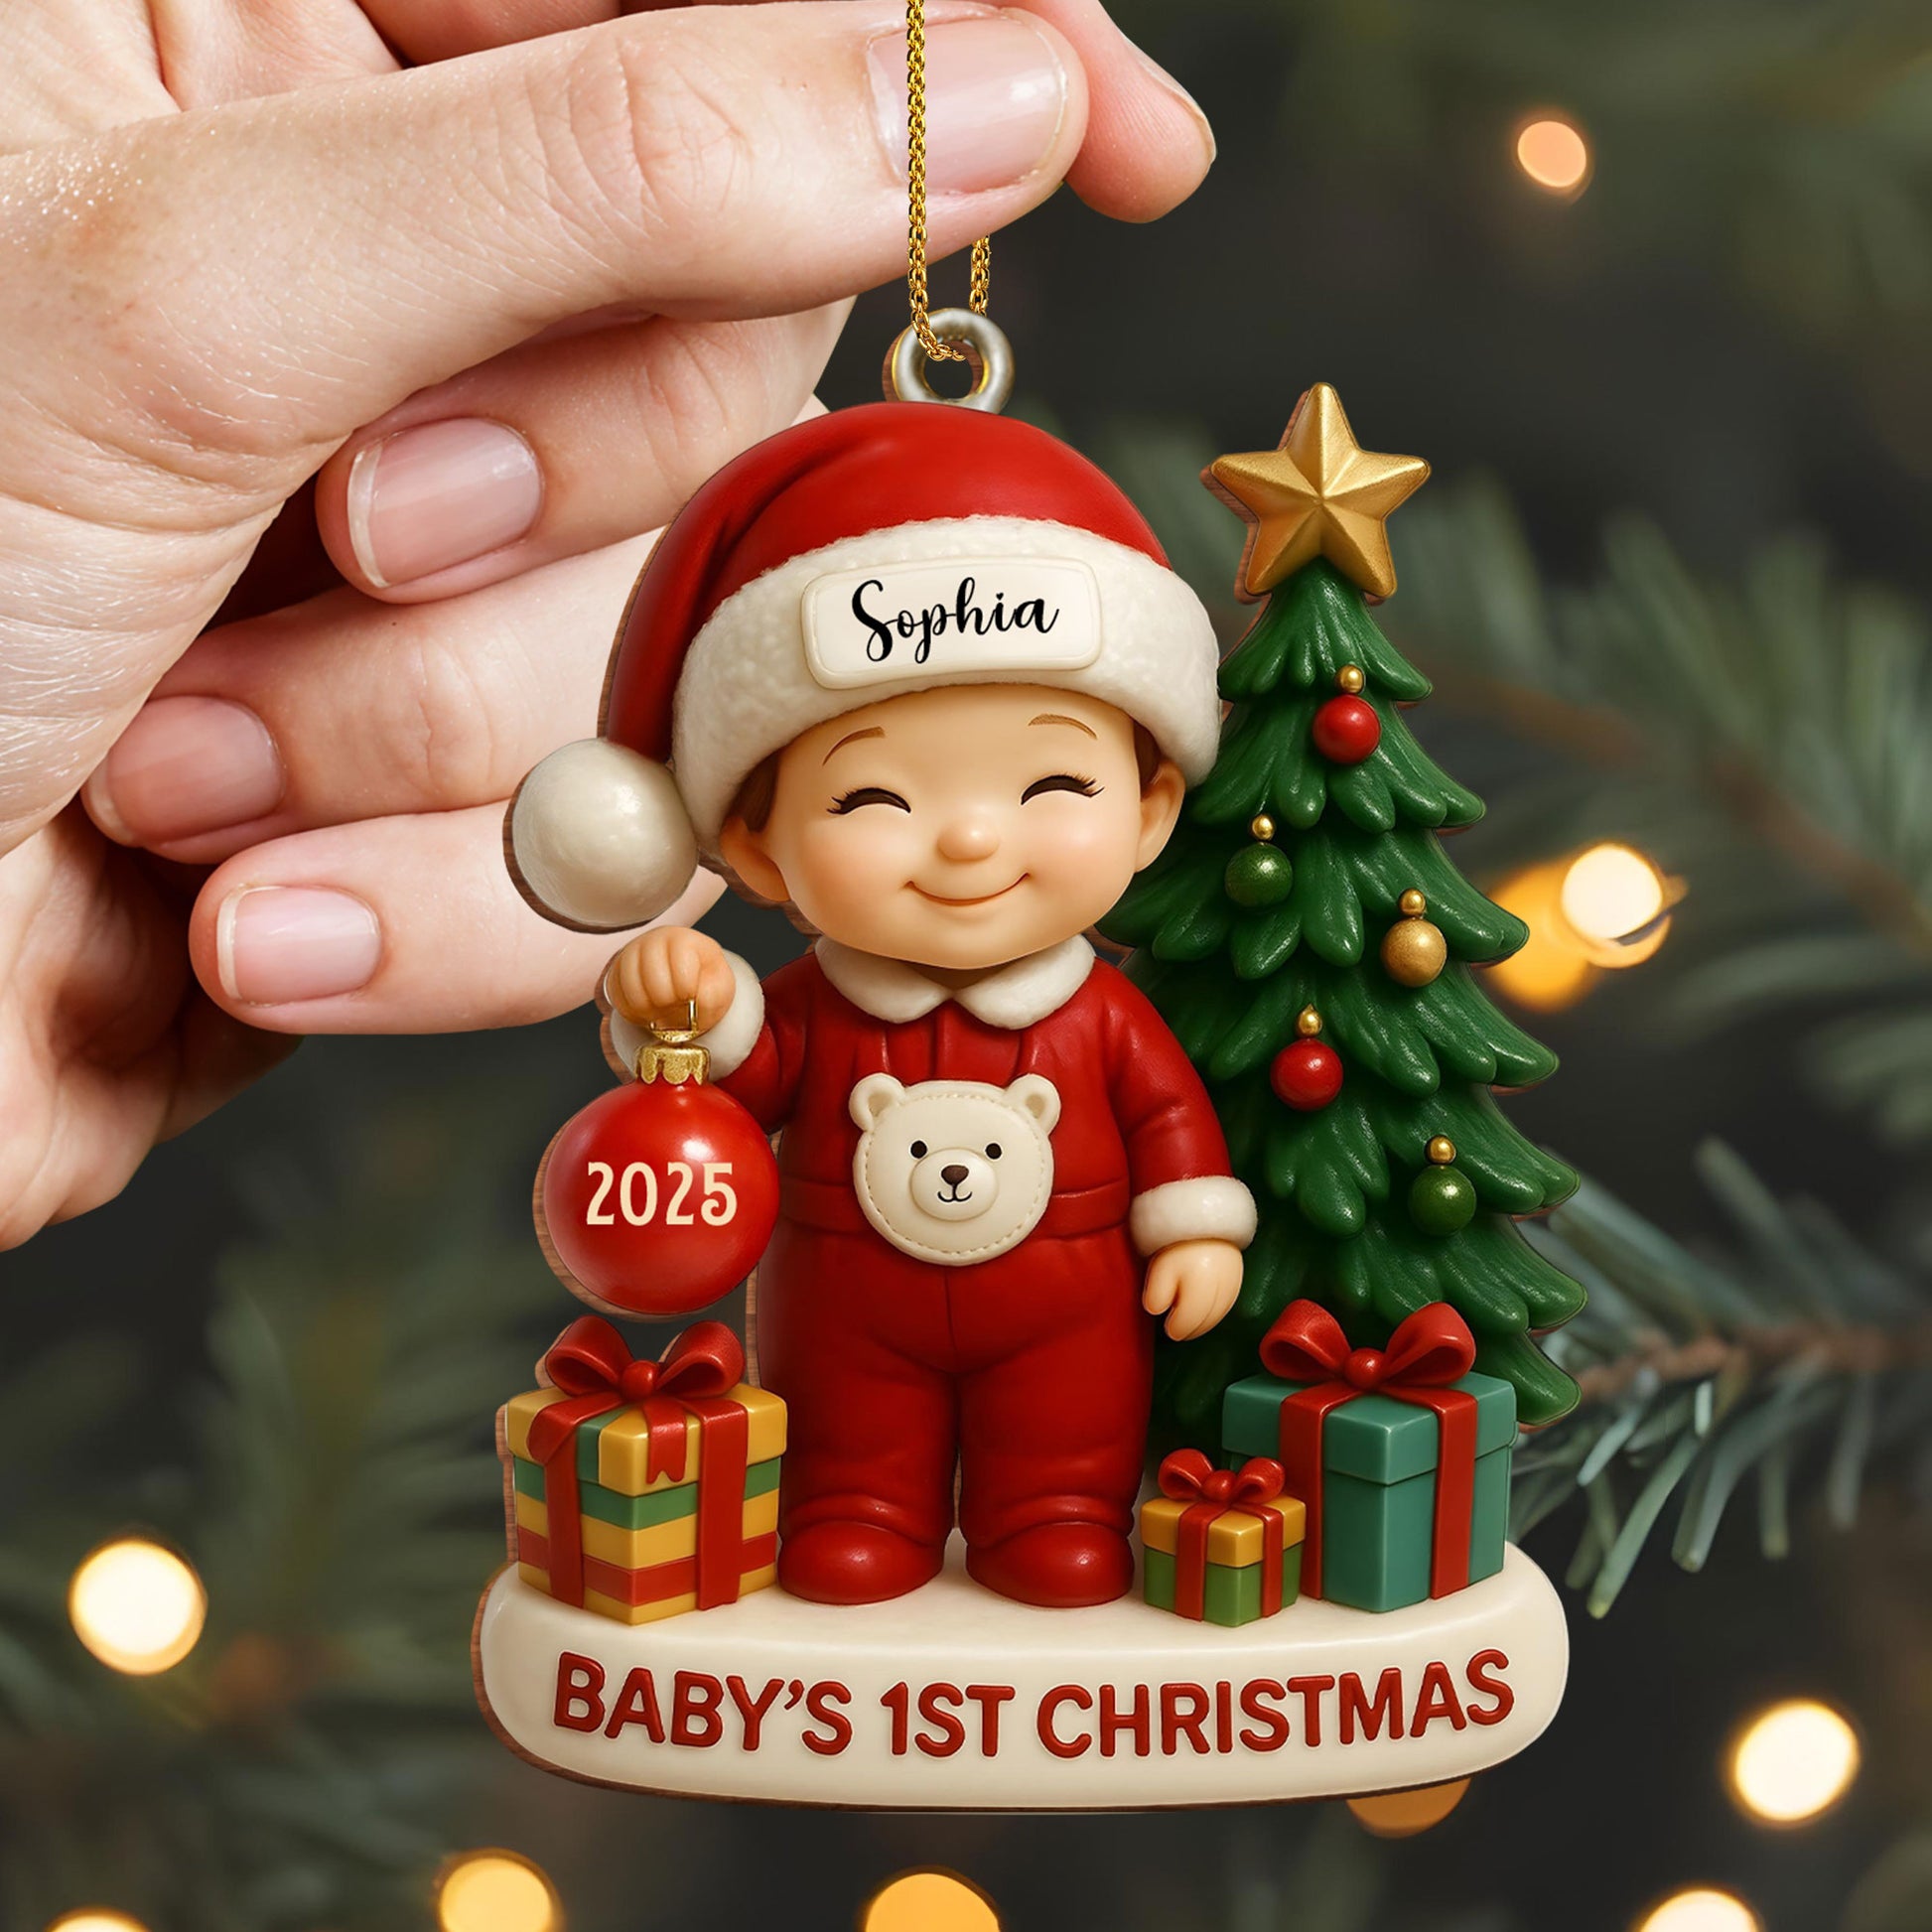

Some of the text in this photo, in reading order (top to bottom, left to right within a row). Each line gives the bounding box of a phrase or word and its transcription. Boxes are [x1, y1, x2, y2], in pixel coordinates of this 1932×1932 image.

[851, 577, 1060, 664] Sophia
[586, 1161, 738, 1227] 2025
[552, 1648, 1515, 1759] BABY’S 1ST CHRISTMAS
